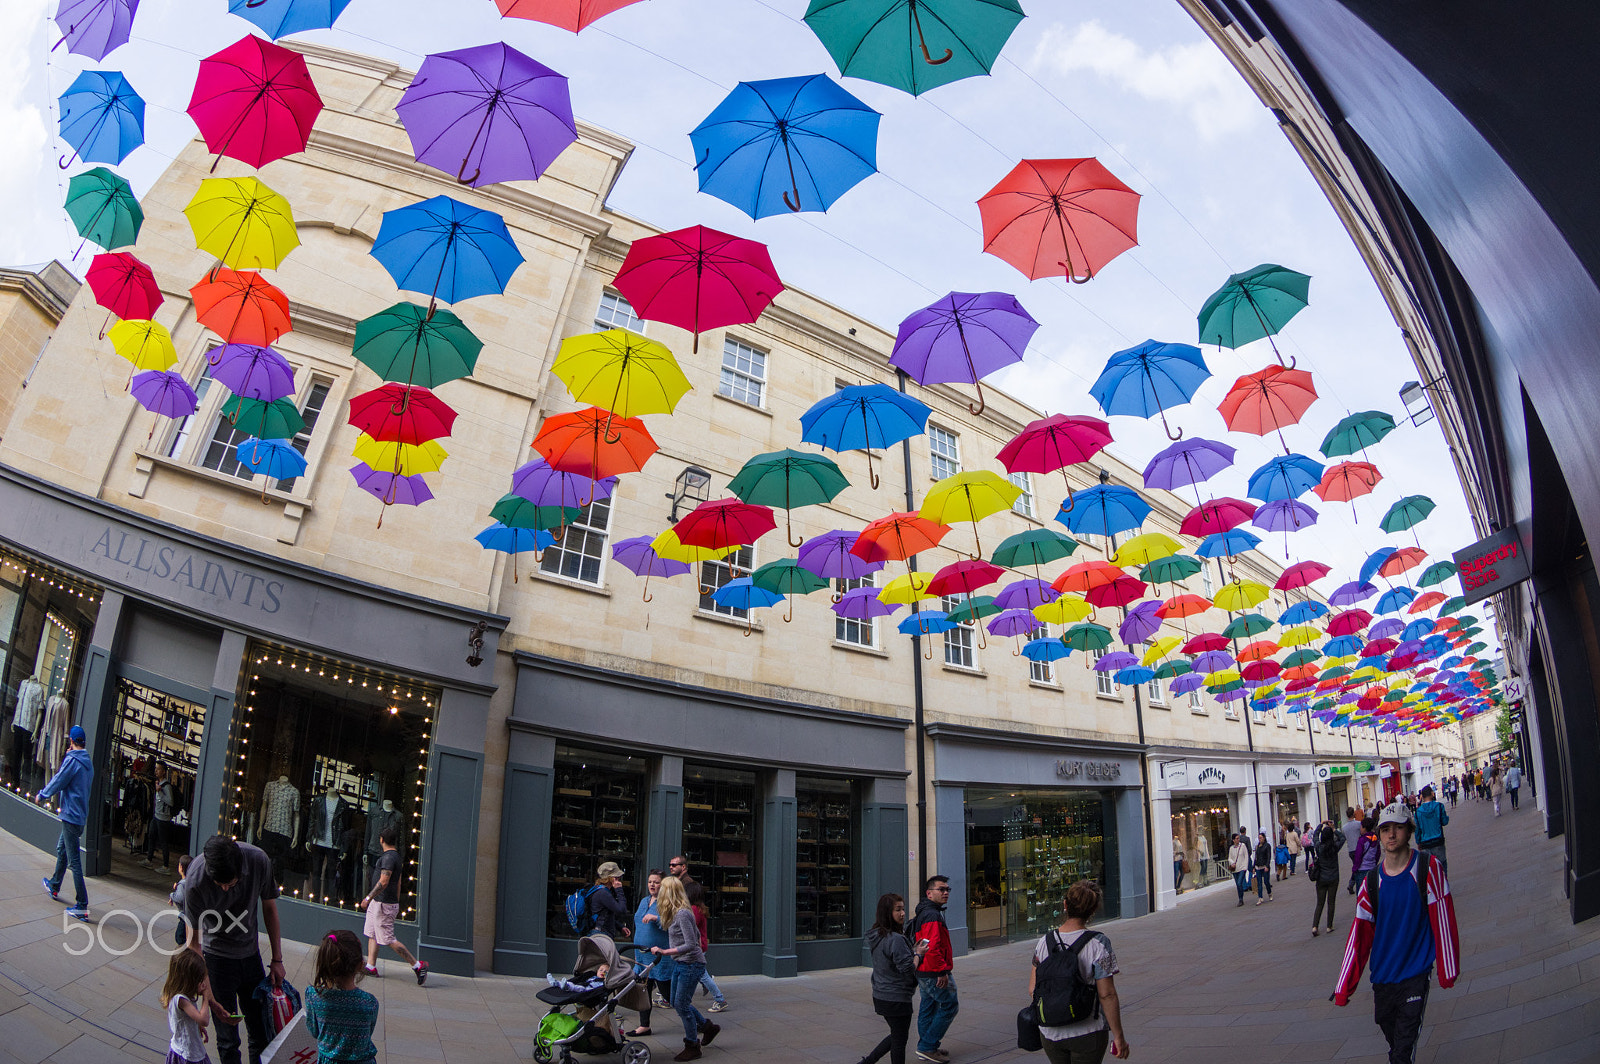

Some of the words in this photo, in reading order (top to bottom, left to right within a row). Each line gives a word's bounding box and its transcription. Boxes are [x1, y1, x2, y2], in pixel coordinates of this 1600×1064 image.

[1460, 541, 1517, 576] Superdry
[90, 526, 285, 614] ALLSAINTS
[1464, 569, 1500, 591] Store.
[1056, 760, 1085, 776] KURT
[1087, 761, 1121, 777] GEIGER
[1198, 767, 1226, 784] FATFACE
